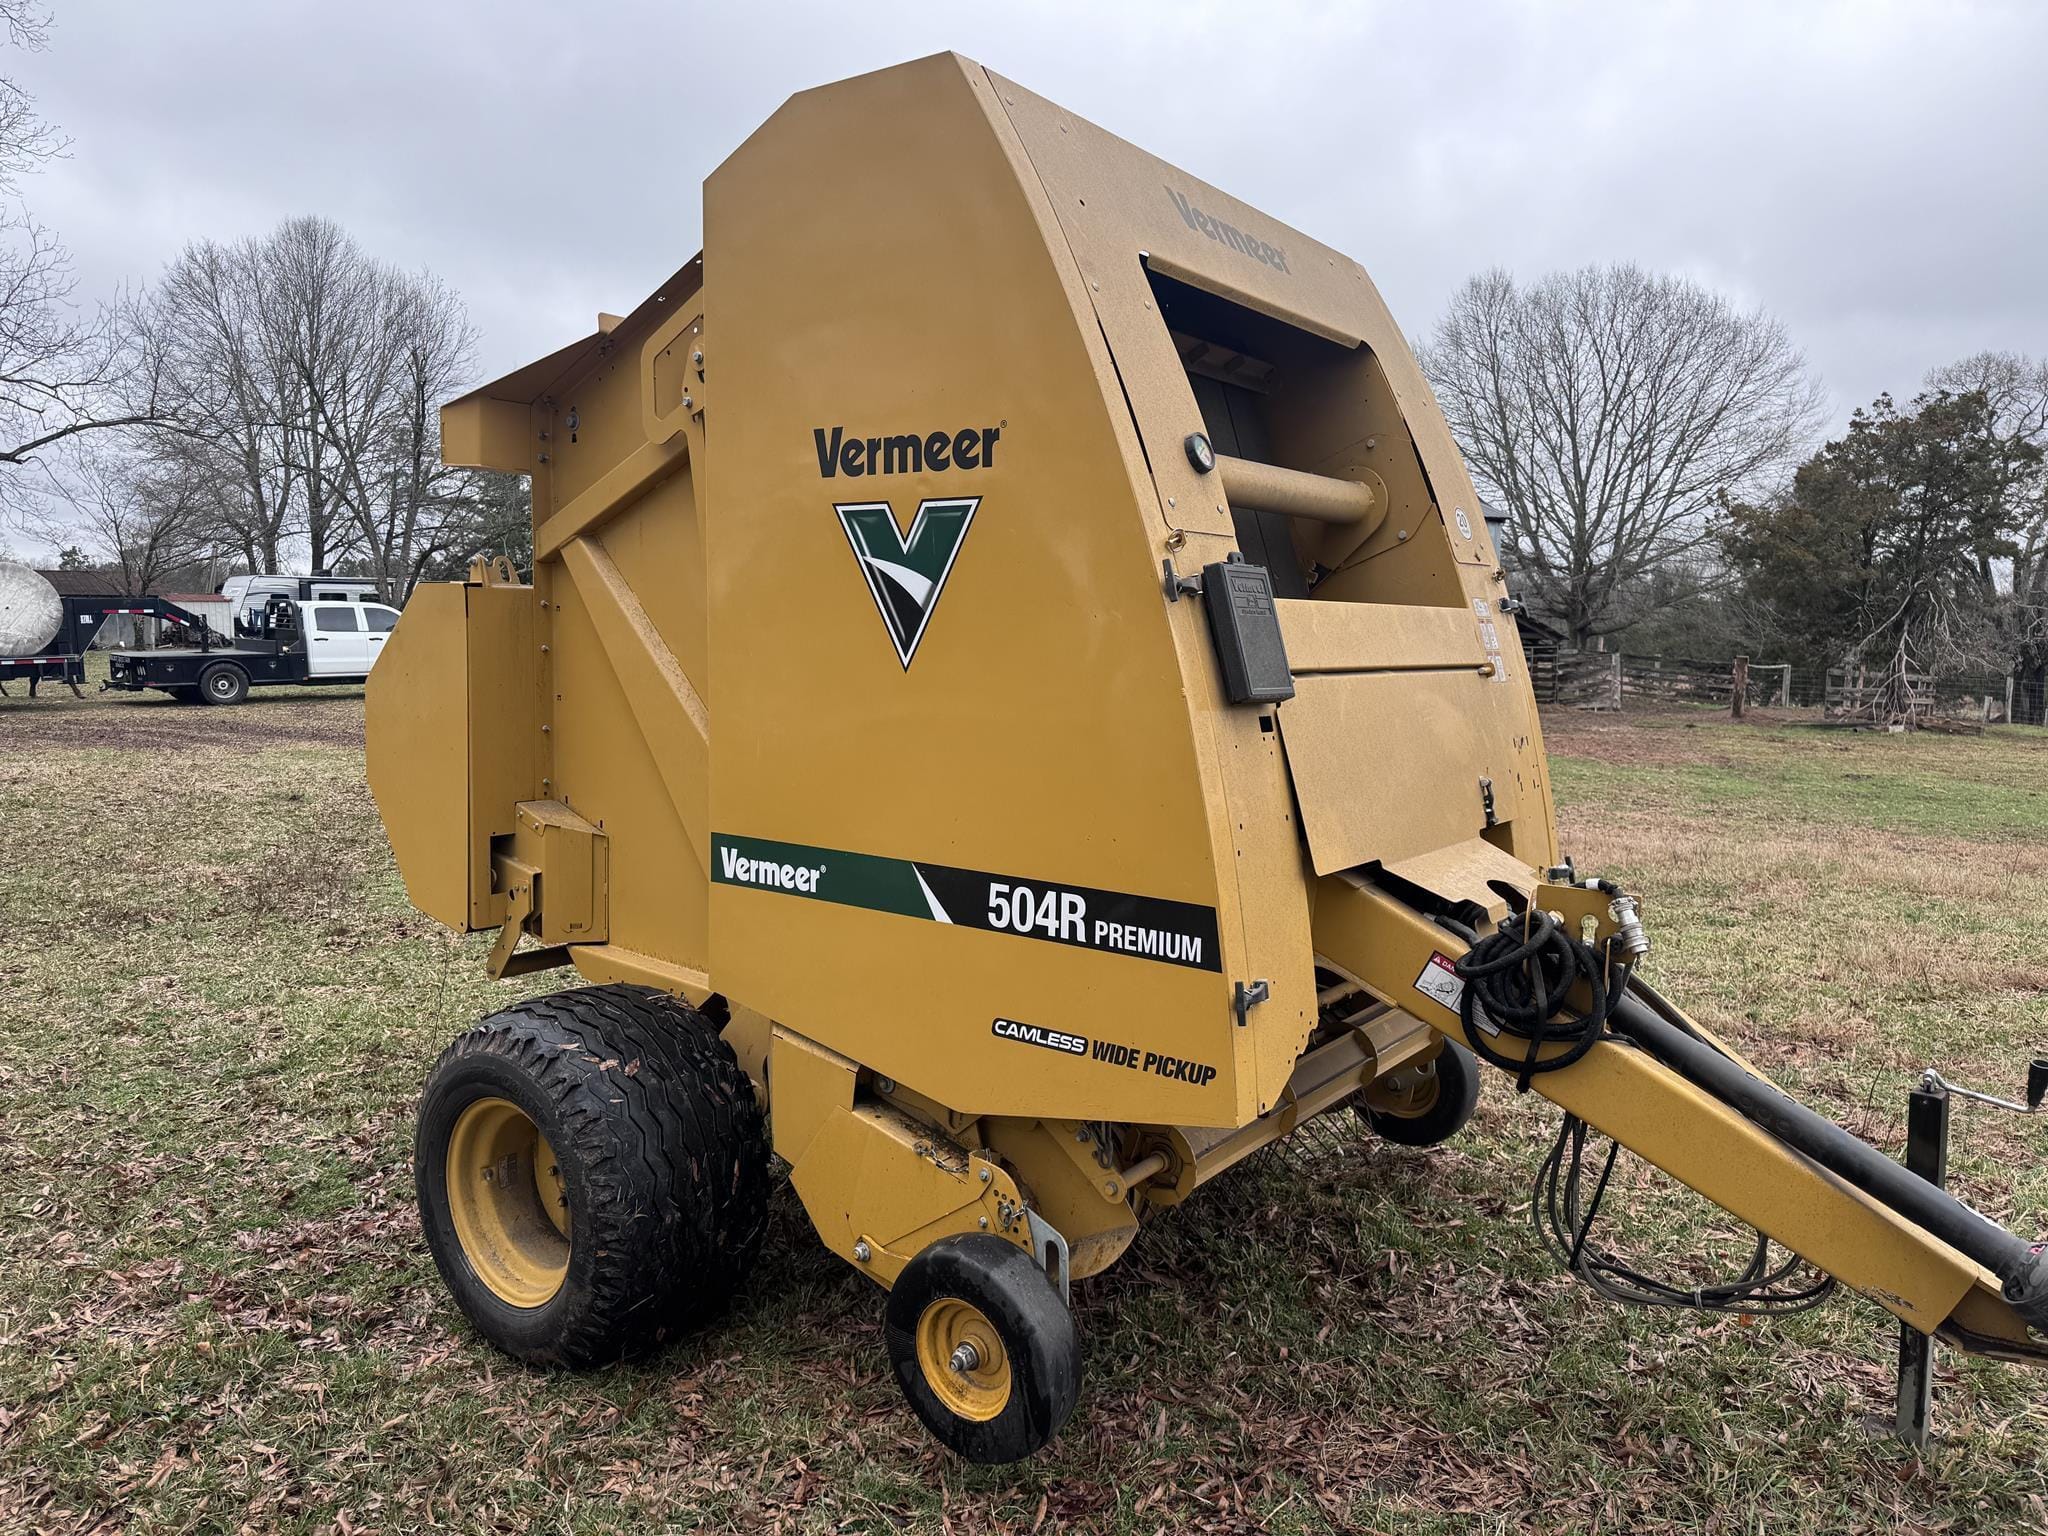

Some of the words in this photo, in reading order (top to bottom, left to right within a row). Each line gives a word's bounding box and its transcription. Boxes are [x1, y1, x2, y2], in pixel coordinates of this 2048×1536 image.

[1163, 184, 1291, 275] Vermeer
[813, 426, 1000, 478] Vermeer
[720, 846, 820, 893] Vermeer
[987, 882, 1087, 943] 504R
[1094, 919, 1203, 963] PREMIUM
[994, 1020, 1086, 1054] CAMLESS
[1092, 1039, 1141, 1070] WIDE
[1142, 1051, 1217, 1087] PICKUP
